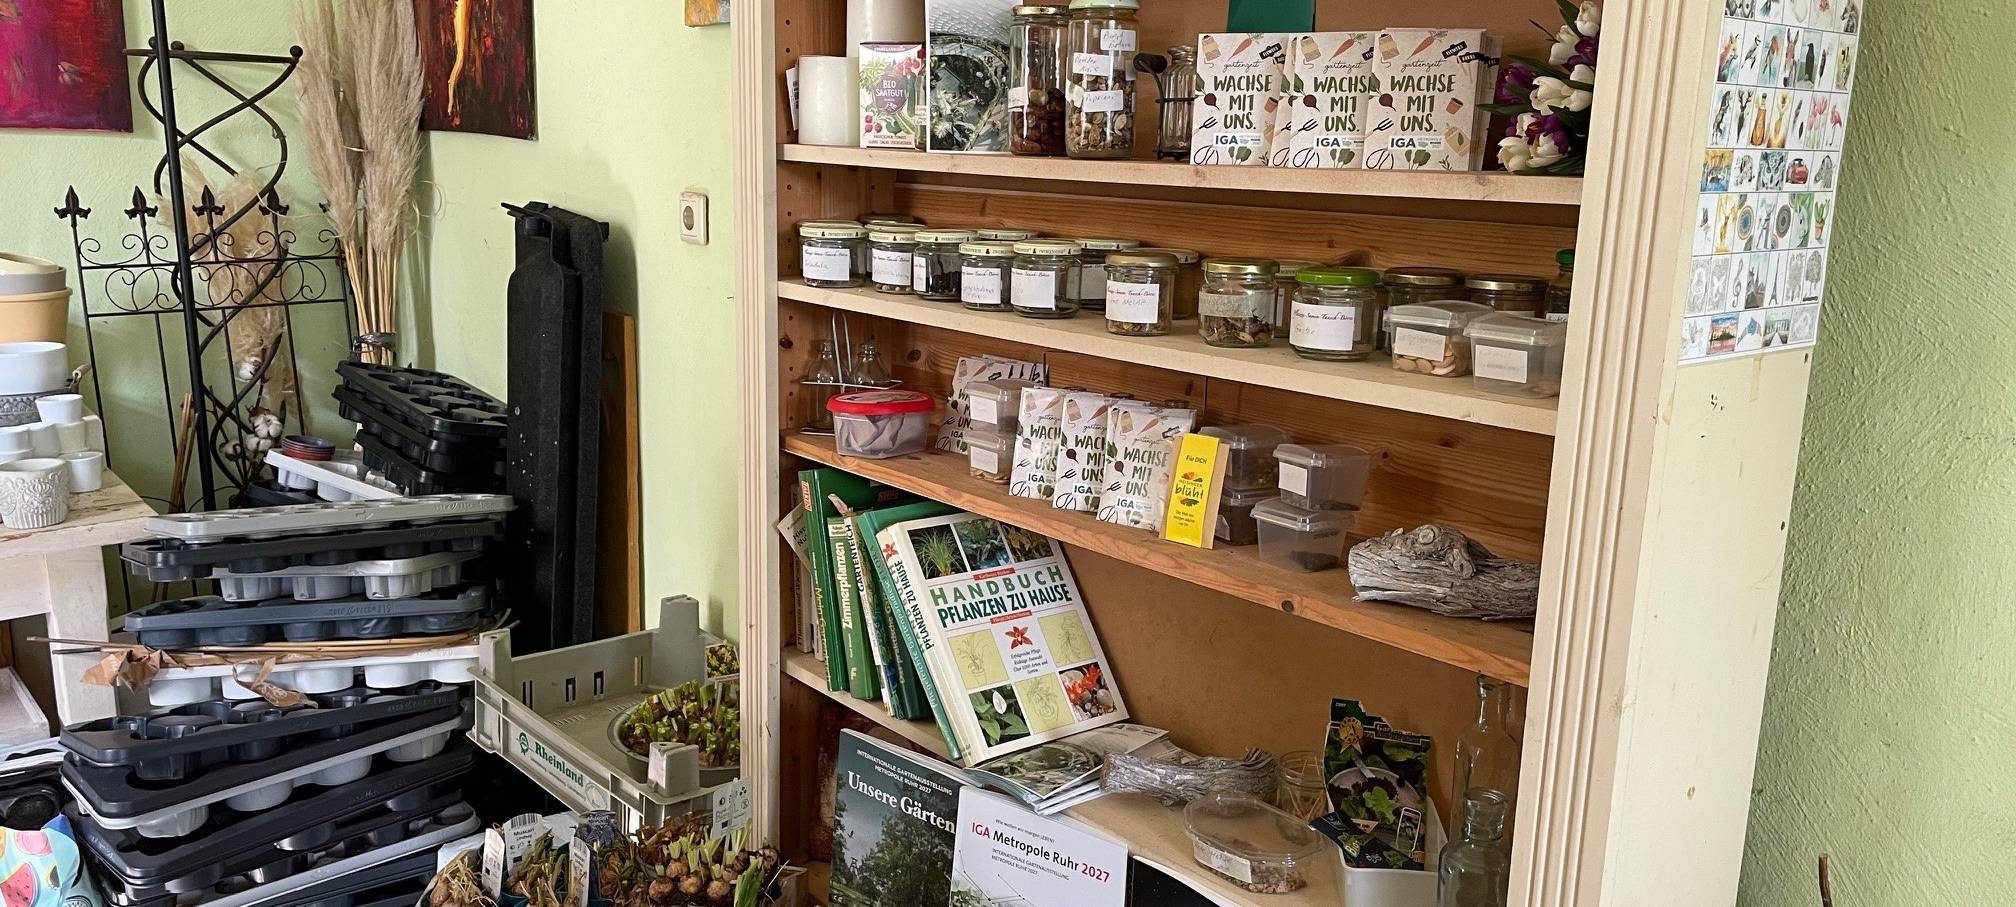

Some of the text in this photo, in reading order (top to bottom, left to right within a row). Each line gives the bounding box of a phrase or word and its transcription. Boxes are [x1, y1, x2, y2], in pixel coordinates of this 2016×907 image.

[883, 80, 896, 88] BIO
[1213, 74, 1273, 92] WACHSE
[1313, 75, 1371, 93] WACHS
[1390, 74, 1456, 93] WACHSE
[875, 89, 904, 97] SAATGUT
[1229, 94, 1254, 111] MIT
[1330, 96, 1356, 112] MIT
[1407, 95, 1435, 112] MIT
[1223, 112, 1257, 130] UNS.
[1324, 114, 1359, 132] UNS.
[1400, 113, 1437, 132] UNS.
[1215, 135, 1238, 145] IGA
[1316, 137, 1340, 147] IGA
[1390, 138, 1416, 148] IGA
[1123, 446, 1169, 467] WACHSE
[1028, 473, 1045, 483] IGA
[1132, 465, 1152, 482] MIT
[1074, 485, 1093, 495] IGA
[1126, 481, 1150, 498] UNS.
[1175, 483, 1204, 499] blüht
[1117, 498, 1135, 509] IGA
[845, 524, 864, 593] GARTENTEICH
[835, 542, 853, 629] Zimmerpflanzen
[929, 565, 1064, 606] HANDBUCH
[815, 587, 823, 615] Mein
[894, 560, 935, 650] PFLANZEN ZU HAUSE
[937, 597, 1007, 628] PFLANZEN
[1007, 592, 1028, 611] ZU
[1028, 583, 1072, 606] HAUSE
[884, 580, 915, 650] Gartenparadiese
[535, 741, 584, 788] Rheinland
[857, 749, 953, 796] INTERNATIONALE GARTENAUSSTELLUNG
[874, 765, 932, 794] METROPOLE RUHR 2027
[847, 770, 956, 834] Unsere Gärten
[972, 822, 1110, 883] IGA Metropole Ruhr 2027
[991, 854, 1015, 867] METROPOLE
[992, 848, 1070, 881] INTERNATIONALE GARTENAUSSTELLUNG
